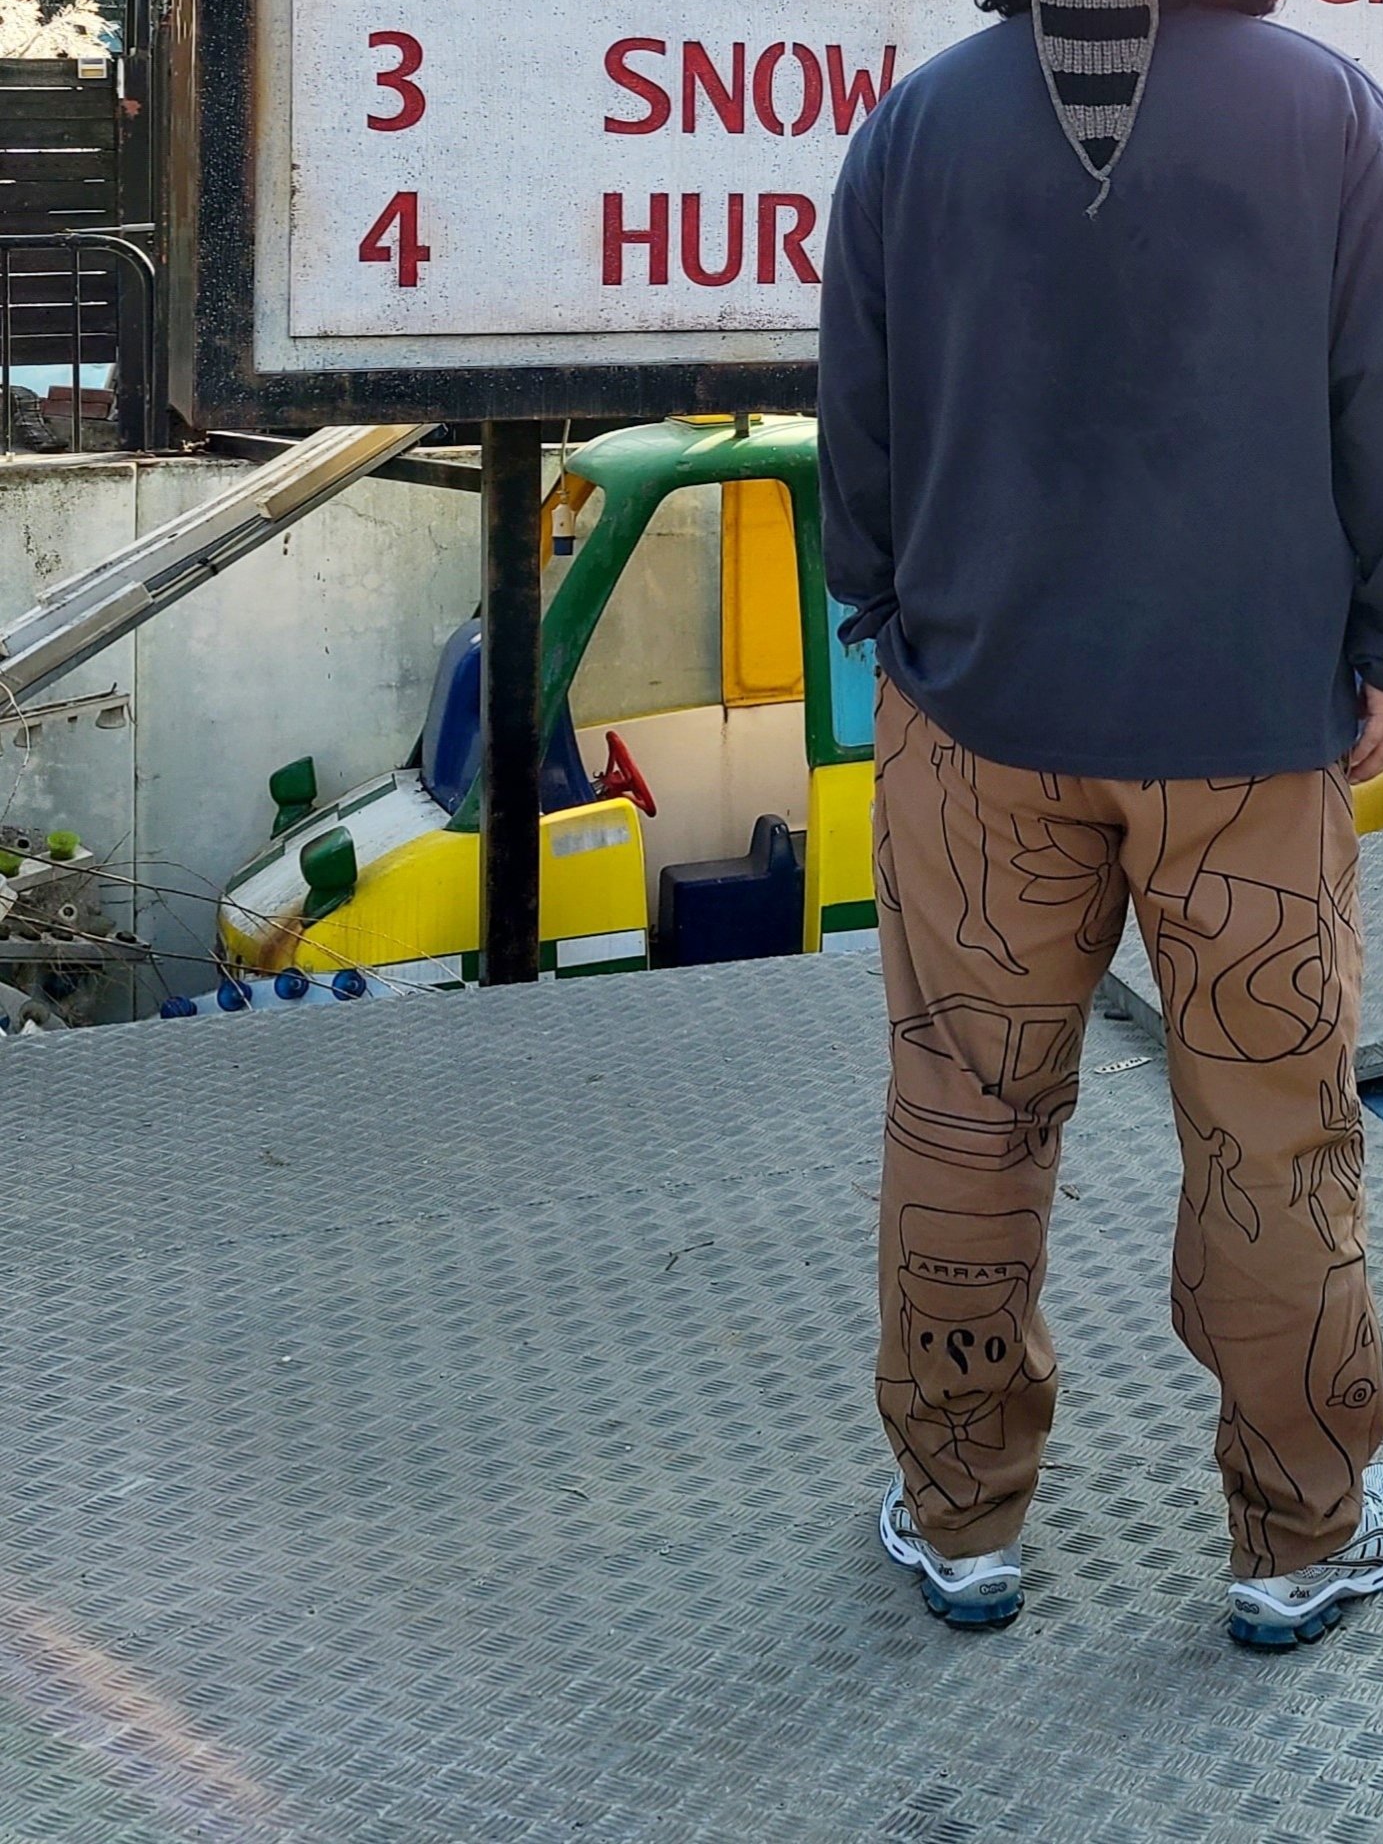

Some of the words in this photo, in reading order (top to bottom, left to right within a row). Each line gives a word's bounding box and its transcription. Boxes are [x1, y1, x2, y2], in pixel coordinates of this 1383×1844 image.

[367, 29, 428, 133] 3
[358, 190, 431, 288] 4
[602, 191, 823, 287] HUR
